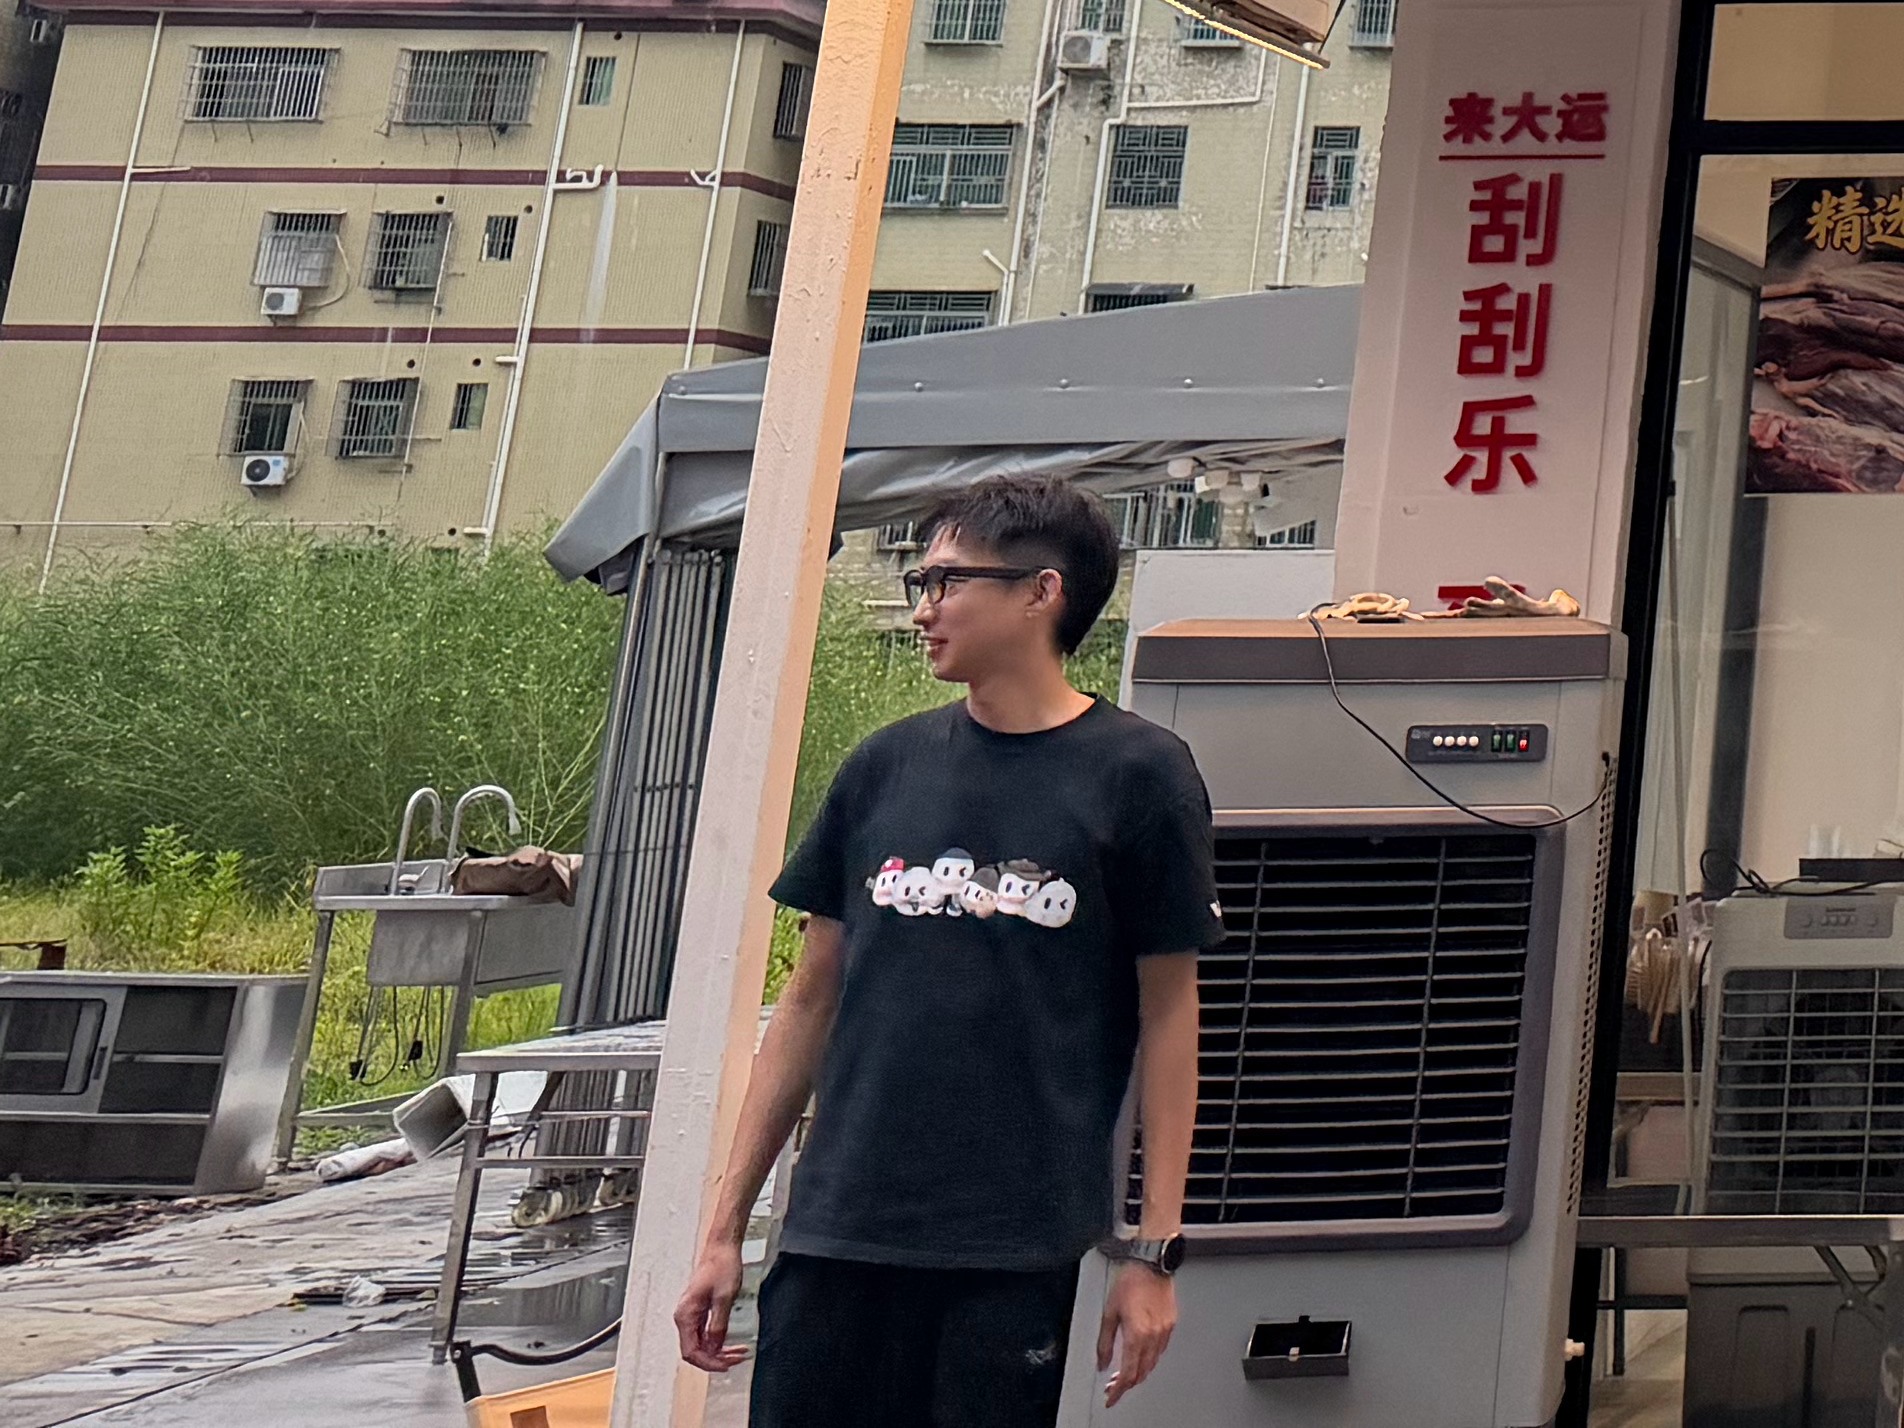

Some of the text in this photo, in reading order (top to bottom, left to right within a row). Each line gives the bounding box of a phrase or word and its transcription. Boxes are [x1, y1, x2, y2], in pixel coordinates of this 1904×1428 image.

[1442, 90, 1609, 145] 来大运
[1443, 172, 1564, 495] 刮刮乐
